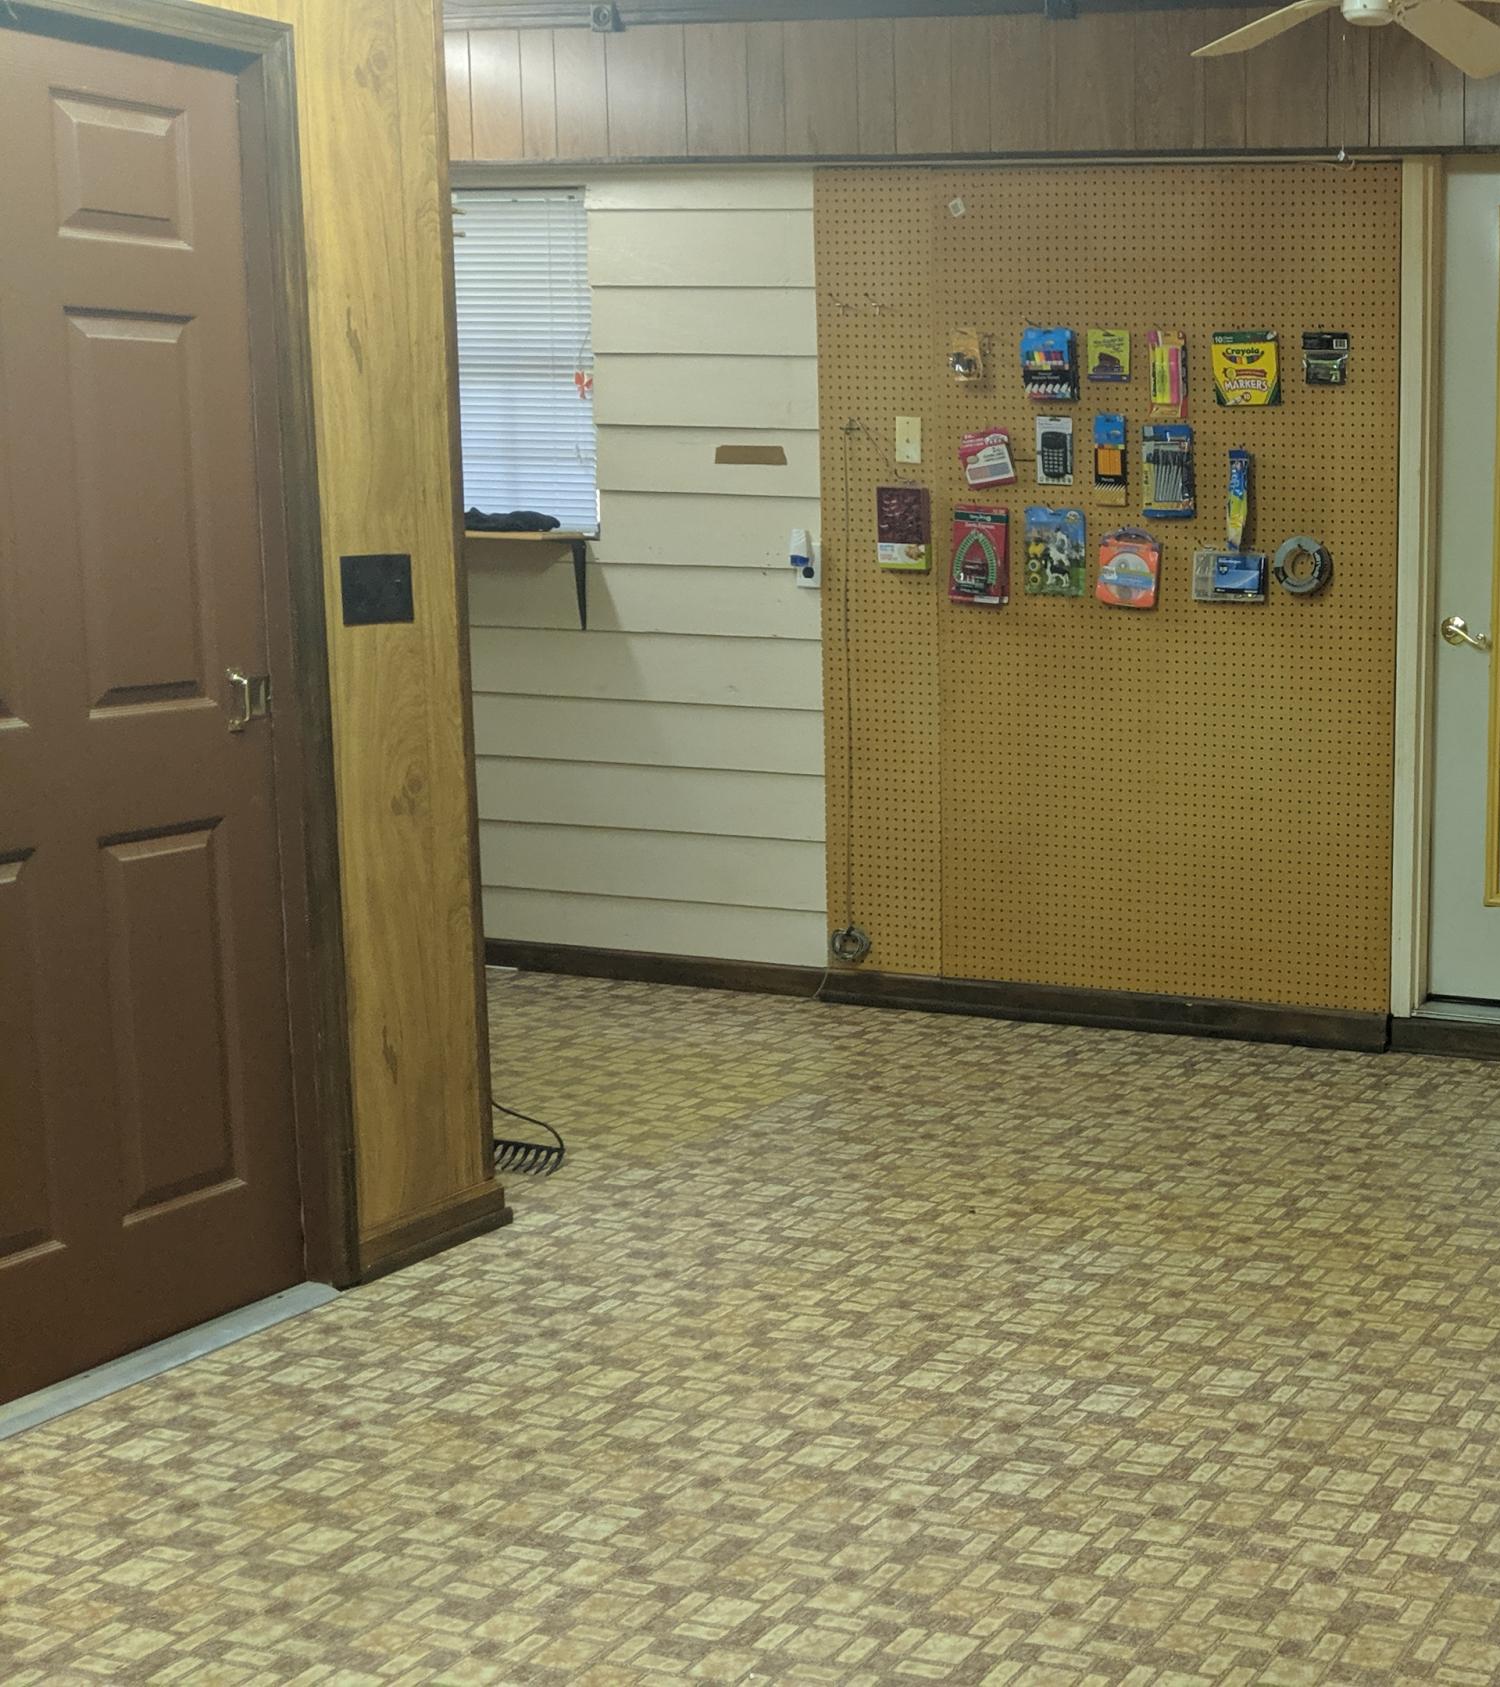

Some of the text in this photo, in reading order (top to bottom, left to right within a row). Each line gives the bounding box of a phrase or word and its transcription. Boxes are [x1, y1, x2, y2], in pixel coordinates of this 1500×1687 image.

[1214, 336, 1223, 344] 10
[1225, 347, 1260, 356] Crayola
[1224, 378, 1268, 392] MARKERS
